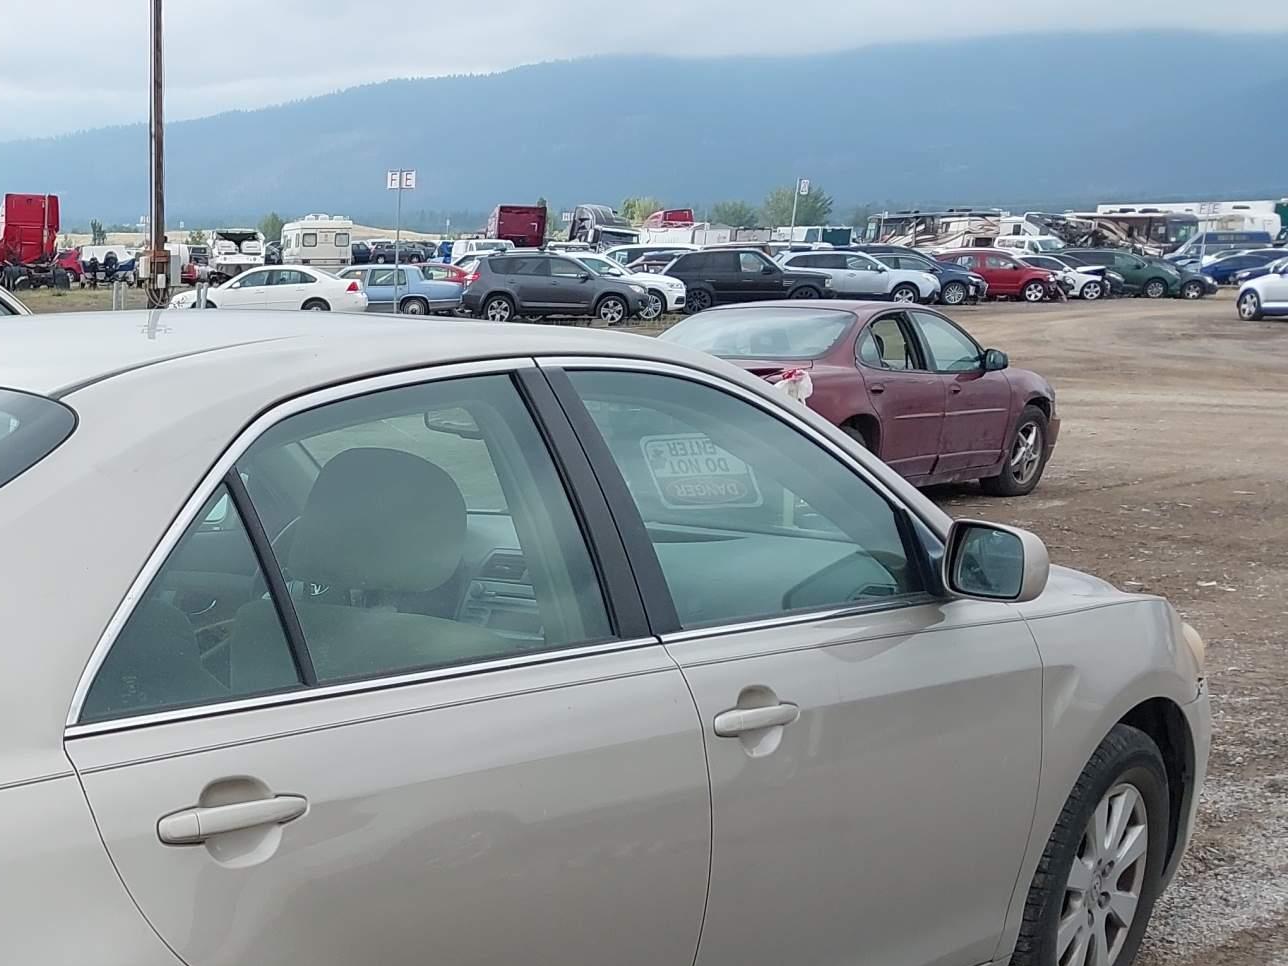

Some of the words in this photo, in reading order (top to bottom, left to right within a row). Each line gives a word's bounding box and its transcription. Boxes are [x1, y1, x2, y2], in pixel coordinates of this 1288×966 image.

[669, 458, 702, 475] NOT
[706, 457, 730, 473] DO
[674, 482, 739, 497] DANGER
